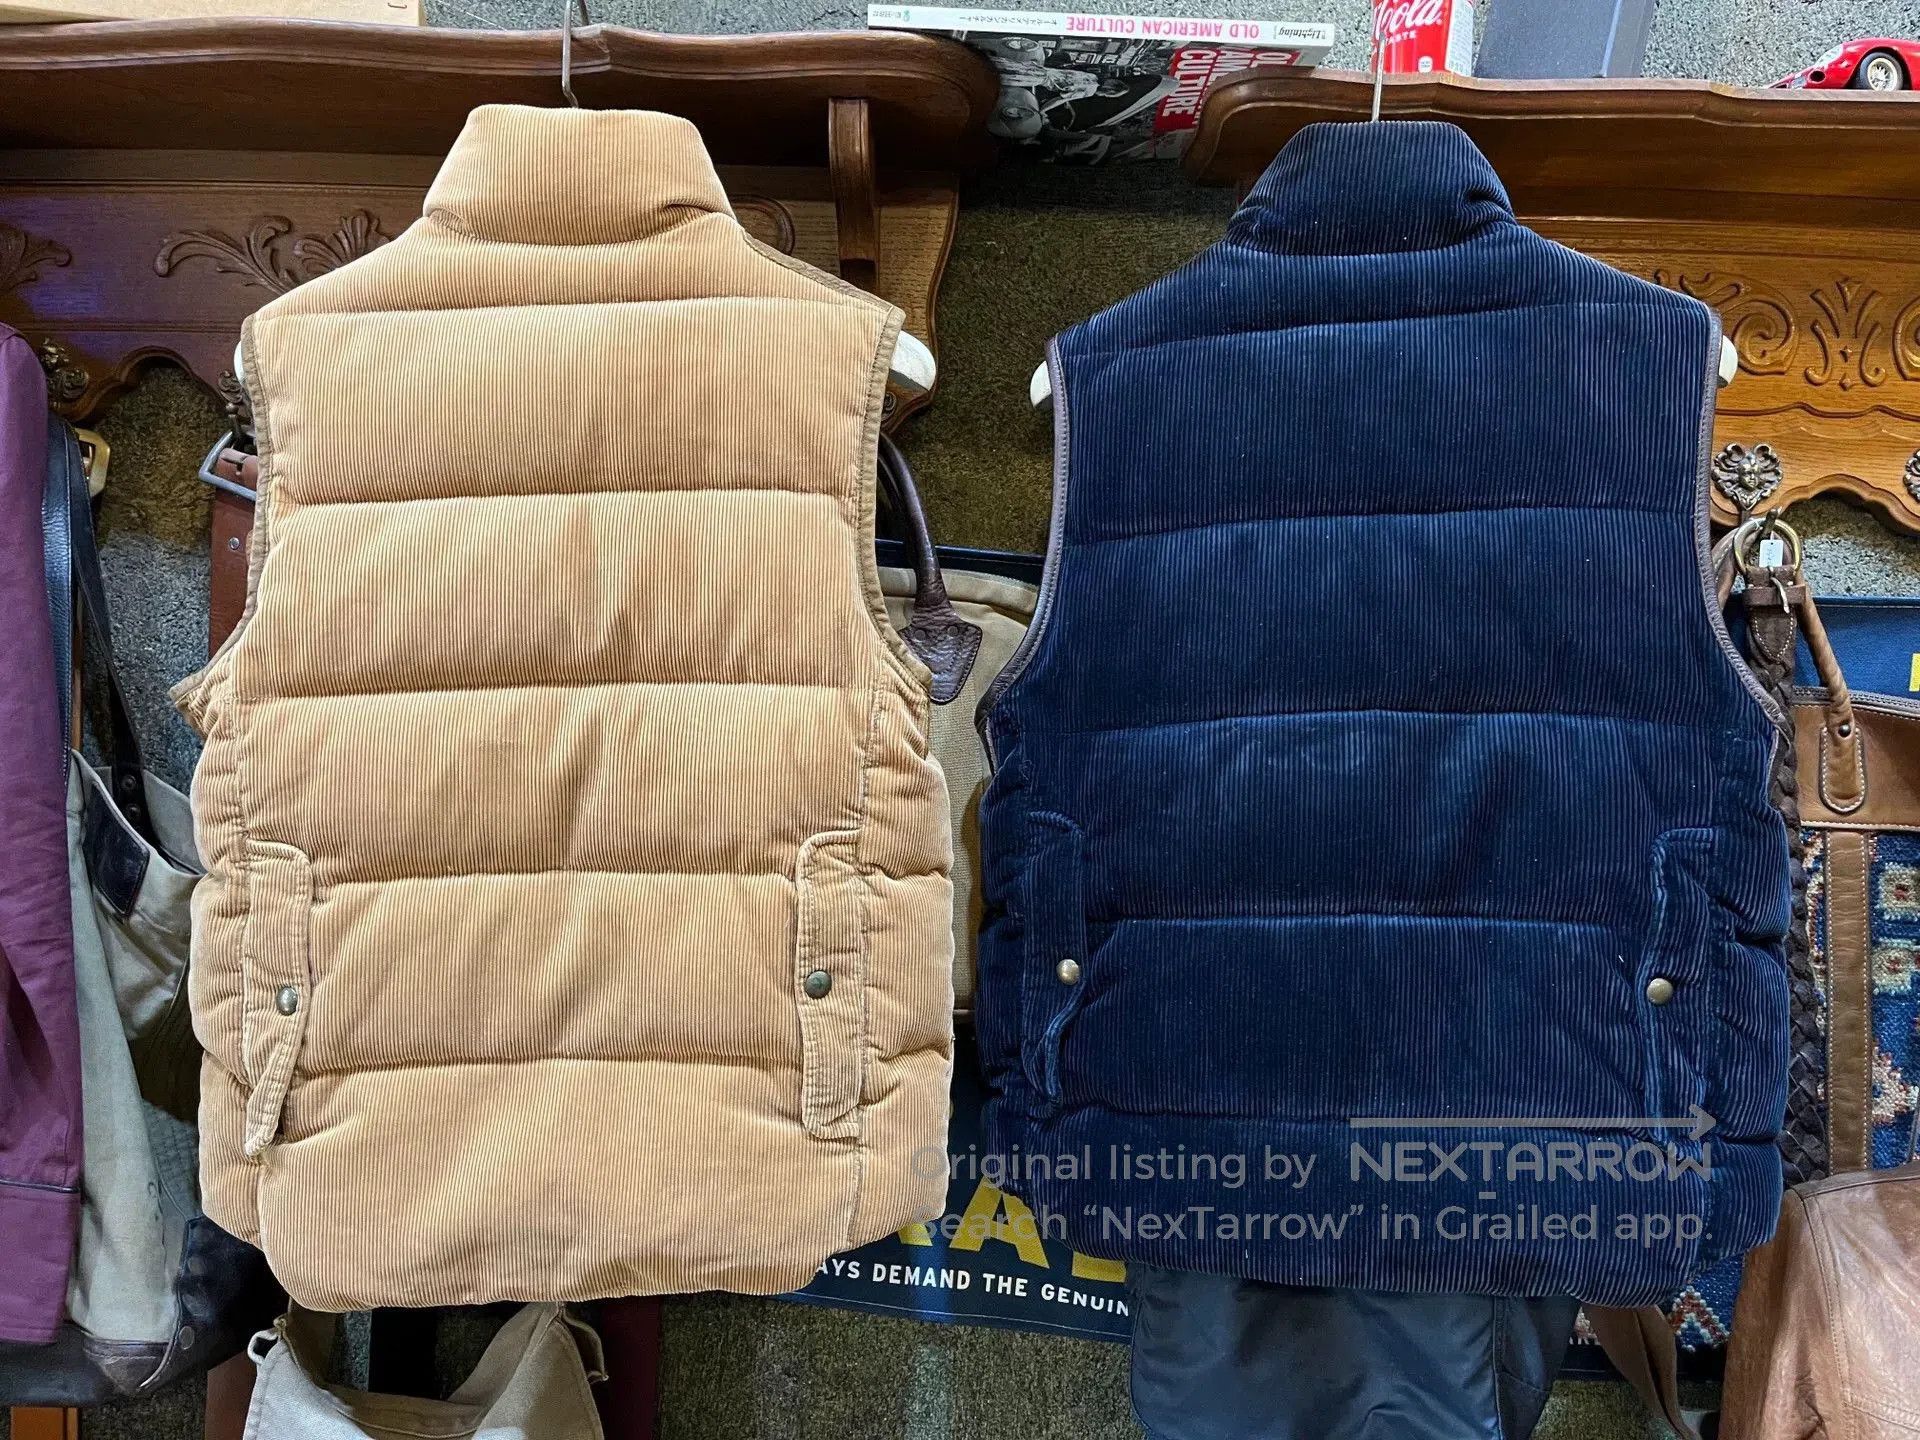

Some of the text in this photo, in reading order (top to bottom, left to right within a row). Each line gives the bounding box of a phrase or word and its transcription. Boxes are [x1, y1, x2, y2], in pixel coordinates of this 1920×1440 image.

[1066, 15, 1260, 40] OLD AMERICAN CULTURE
[1278, 26, 1321, 40] Lightning
[1162, 49, 1217, 117] CULTURE
[814, 1257, 1130, 1318] AYS DEMAND THE GENUIN
